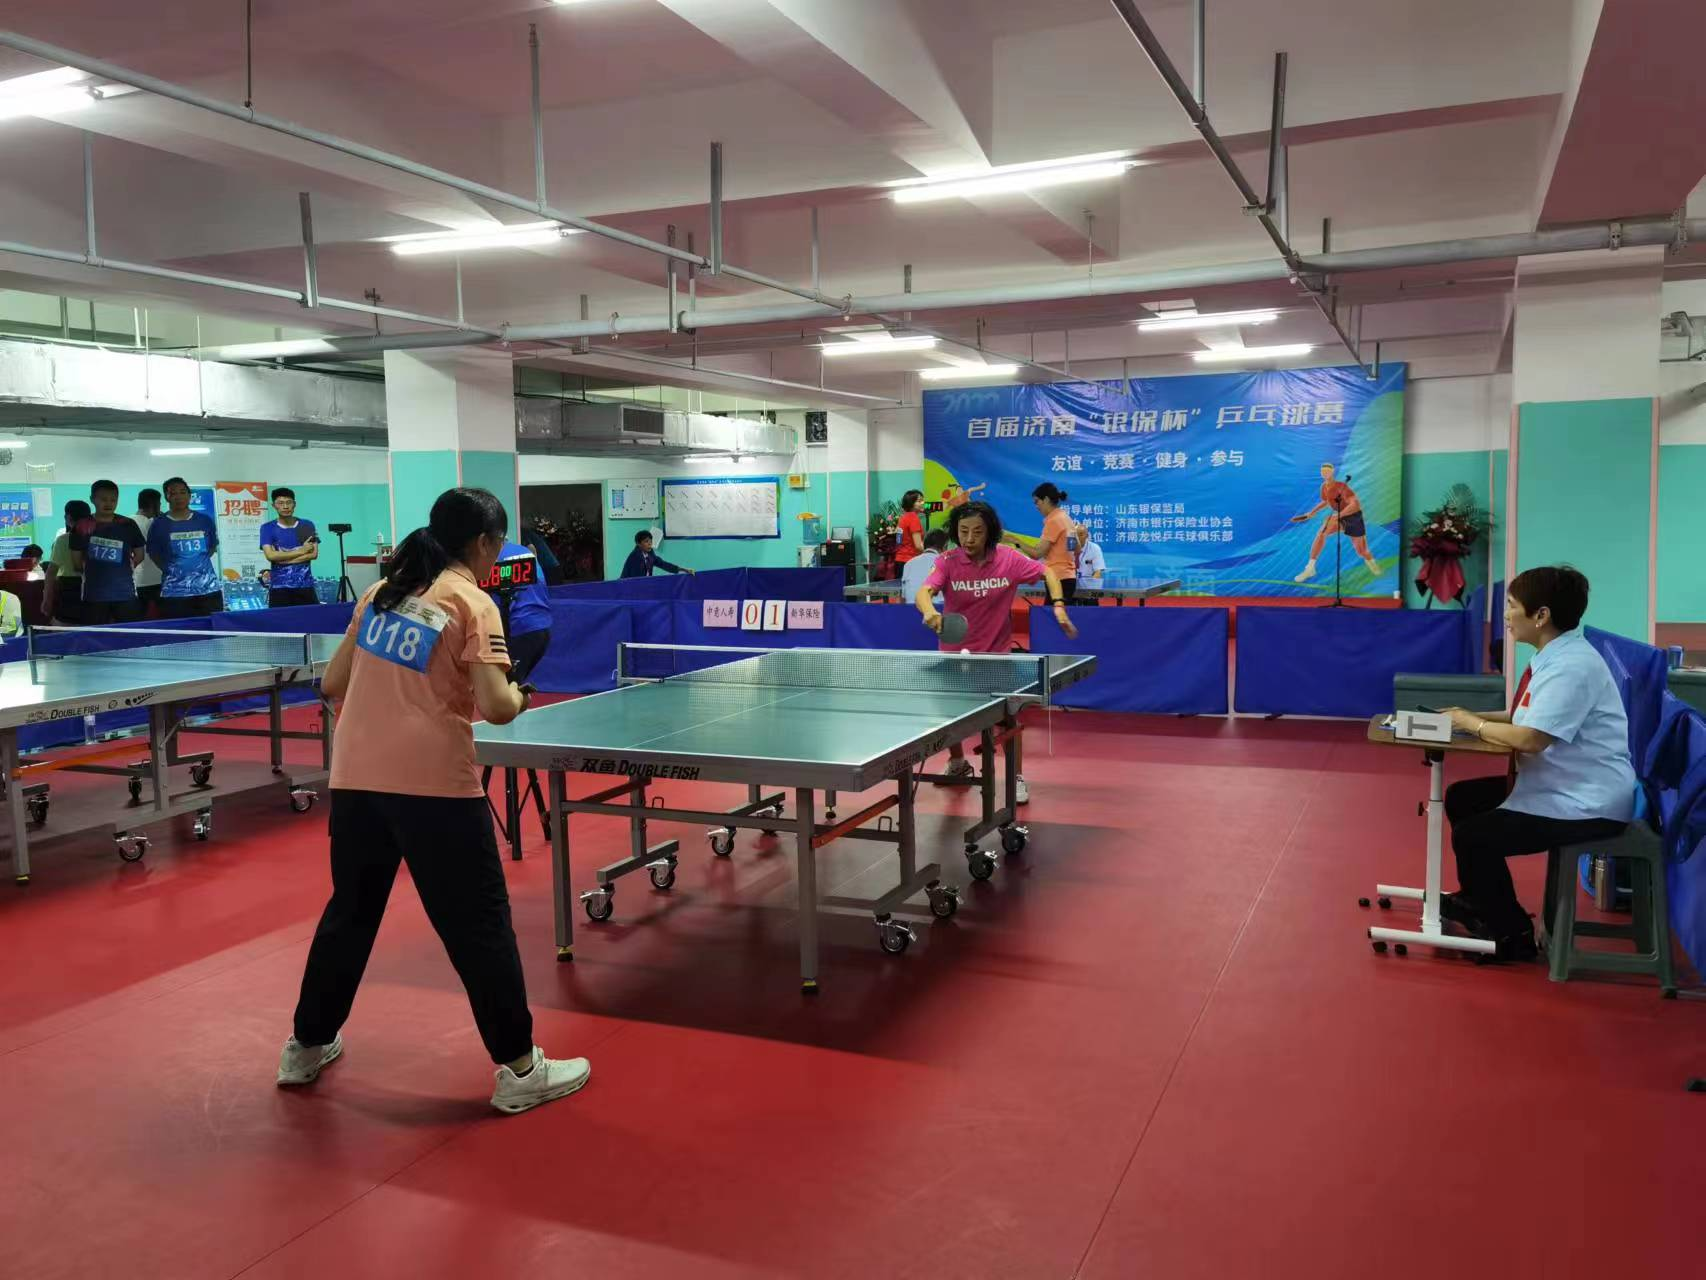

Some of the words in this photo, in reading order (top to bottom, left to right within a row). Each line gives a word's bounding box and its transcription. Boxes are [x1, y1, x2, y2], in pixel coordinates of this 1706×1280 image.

[92, 547, 117, 560] 173
[176, 540, 201, 552] 113
[512, 562, 531, 583] 02
[951, 576, 1009, 592] VALENCIA
[745, 603, 758, 625] 0
[770, 604, 779, 625] 1
[366, 613, 422, 661] 018
[51, 708, 82, 719] DOUBLE
[84, 704, 100, 714] FISH
[581, 758, 616, 774] 双鱼
[618, 760, 671, 778] DOUBLE
[669, 766, 700, 780] FISH
